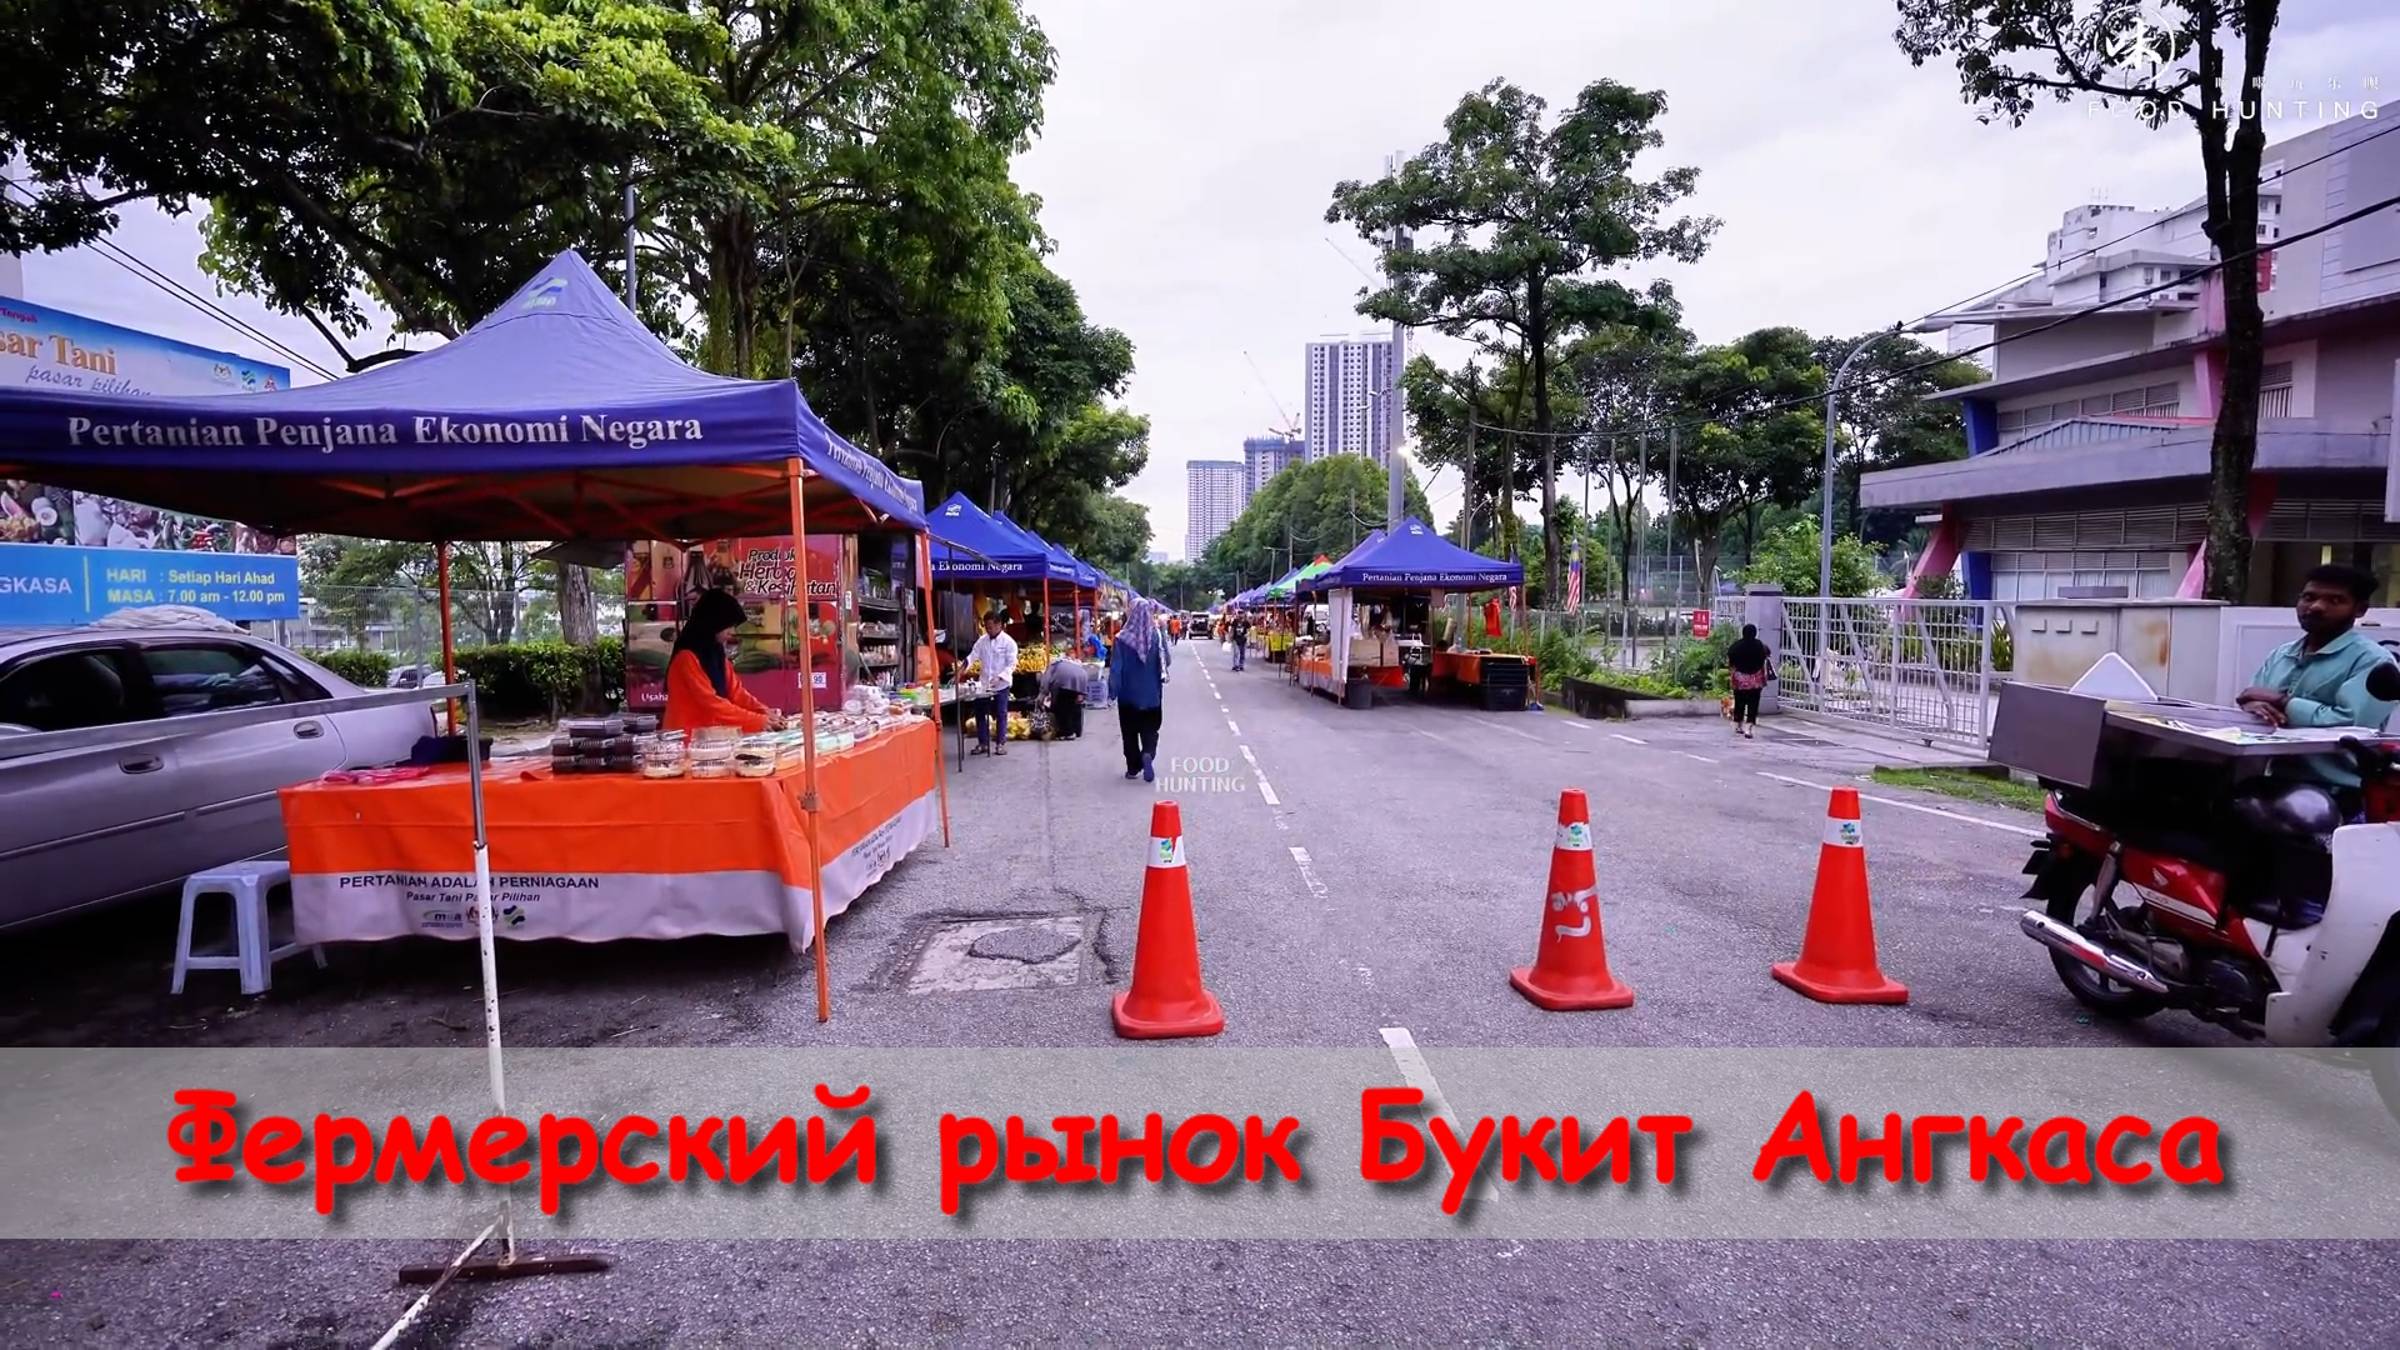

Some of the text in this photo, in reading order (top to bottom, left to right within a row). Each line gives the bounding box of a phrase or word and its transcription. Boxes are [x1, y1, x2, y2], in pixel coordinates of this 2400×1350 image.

[48, 334, 118, 376] Tani
[25, 364, 84, 389] pasar
[67, 413, 704, 454] Pertanian Penjana Ekonomi Negara
[938, 560, 985, 571] Ekonomi
[987, 561, 1023, 573] Negara
[106, 568, 147, 583] HARI
[167, 569, 211, 586] Setiap
[215, 570, 241, 585] Hari
[244, 571, 275, 585] Ahad
[1362, 572, 1508, 584] Pertanian Penjana Ekonomi Negara
[757, 580, 836, 595] Kesihtan
[106, 589, 155, 602] MASA
[167, 589, 197, 603] 7.00
[200, 592, 220, 602] am
[232, 590, 263, 603] 12.00
[266, 592, 285, 605] pm
[339, 876, 600, 889] PERTANIAN ADALH PERNIAGAAN
[406, 891, 541, 903] Pasar Tani Par Pilihan
